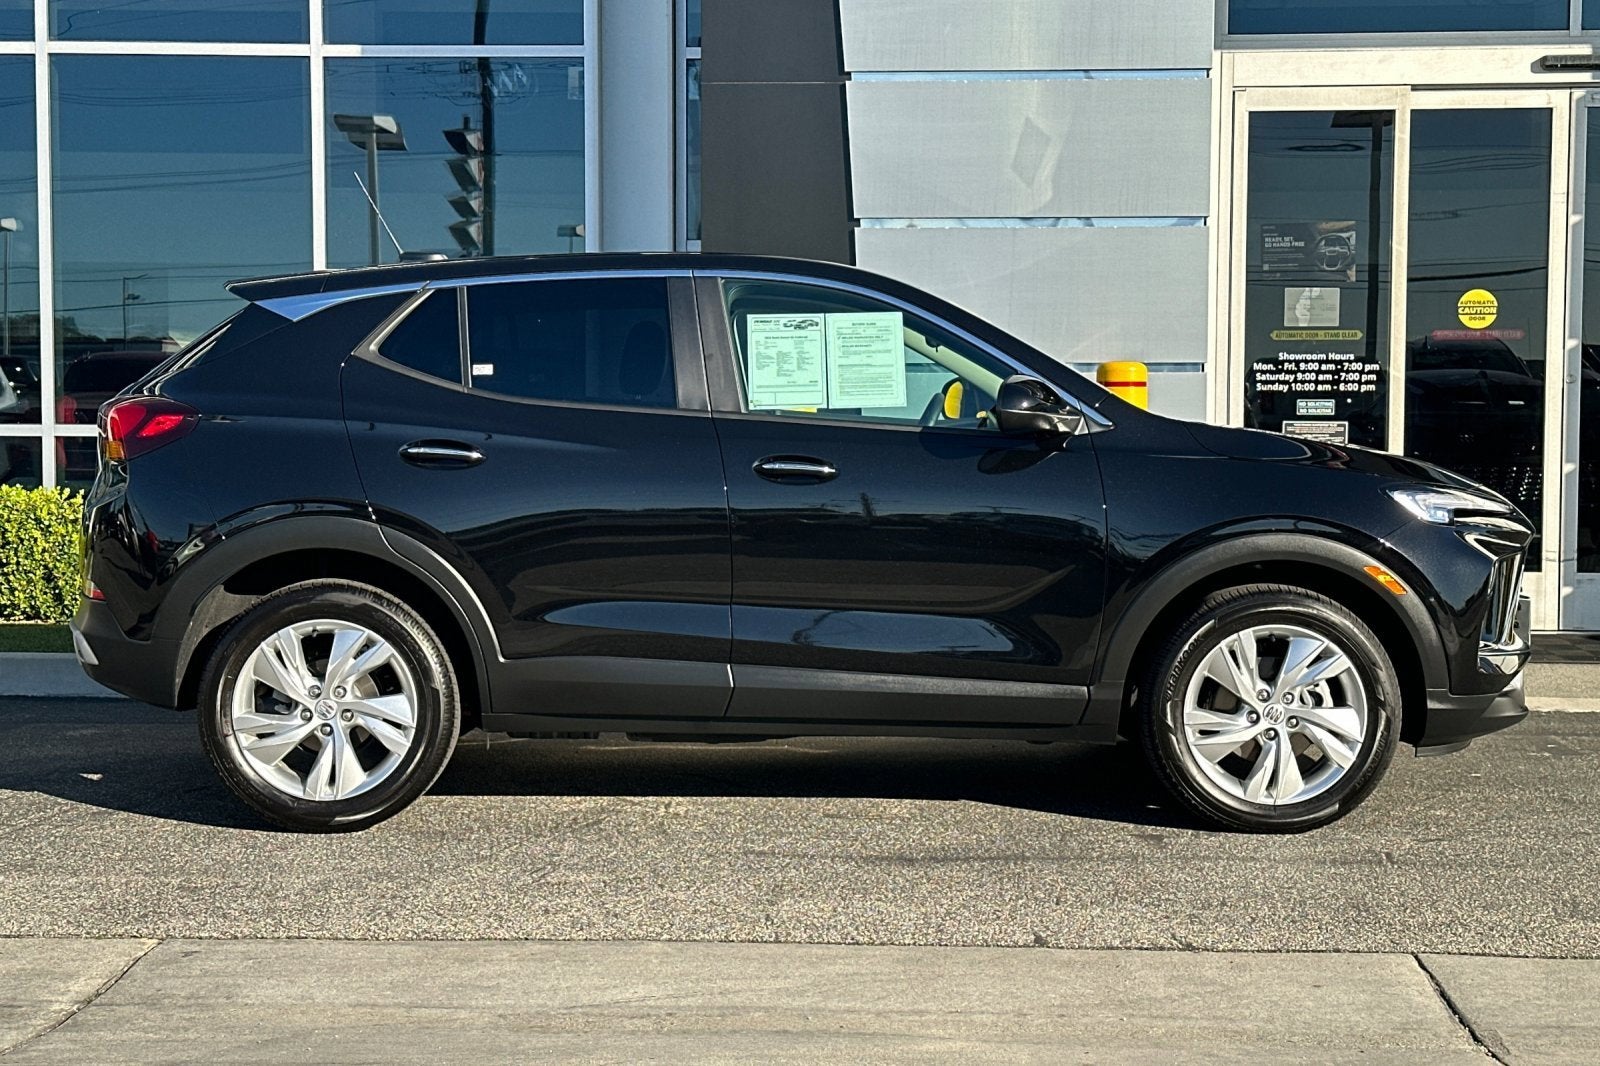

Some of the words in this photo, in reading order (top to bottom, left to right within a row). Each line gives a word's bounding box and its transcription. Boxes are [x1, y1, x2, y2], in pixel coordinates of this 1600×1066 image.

[1458, 306, 1497, 315] CAUTION
[1275, 331, 1304, 339] AUTOMATIC
[1304, 331, 1319, 339] DOOR
[1323, 331, 1341, 339] STAND
[1278, 352, 1326, 360] Showroom
[1328, 352, 1355, 360] Hours
[1253, 362, 1276, 371] Mon.
[1283, 362, 1298, 371] Fri.
[1299, 362, 1319, 371] 9:00
[1342, 362, 1362, 371] 7:00
[1364, 364, 1380, 373] pm
[1255, 373, 1295, 382] Saturday
[1296, 373, 1316, 381] 9:00
[1339, 373, 1359, 381] 7:00
[1361, 374, 1377, 383] pm
[1256, 383, 1289, 392] Sunday
[1291, 383, 1315, 391] 10:00
[1338, 383, 1359, 391] 6:00
[1360, 384, 1376, 393] pm
